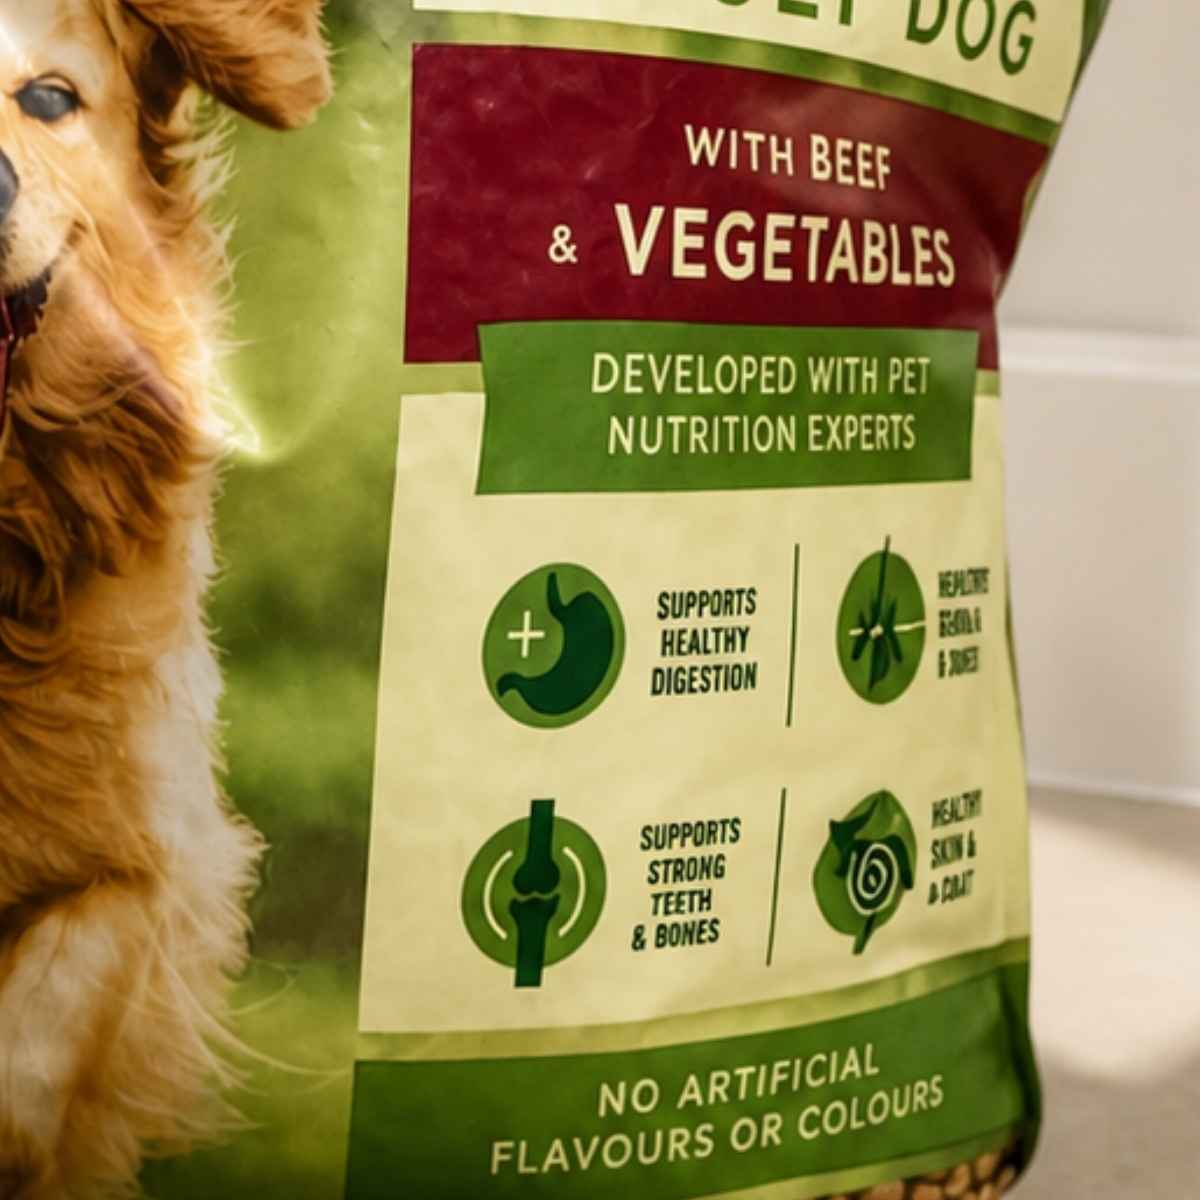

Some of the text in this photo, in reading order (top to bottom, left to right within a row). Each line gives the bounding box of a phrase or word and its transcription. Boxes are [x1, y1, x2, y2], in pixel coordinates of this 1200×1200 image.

[684, 124, 891, 190] WITH BEEF
[548, 203, 955, 288] & VEGETABLES
[591, 352, 932, 396] DEVELOPED WITH PET
[608, 413, 917, 455] NUTRITION EXPERTS
[657, 586, 757, 620] SUPPORTS
[661, 625, 749, 657] HEALTHY
[650, 661, 757, 696] DIGESTION
[640, 816, 741, 851] SUPPORTS
[647, 853, 726, 885] STRONG
[650, 887, 712, 917] TEETH
[631, 917, 721, 952] & BONES
[599, 1043, 881, 1118] NO ARTIFICIAL
[491, 1074, 945, 1175] FLAVOURS OR COLOURS
